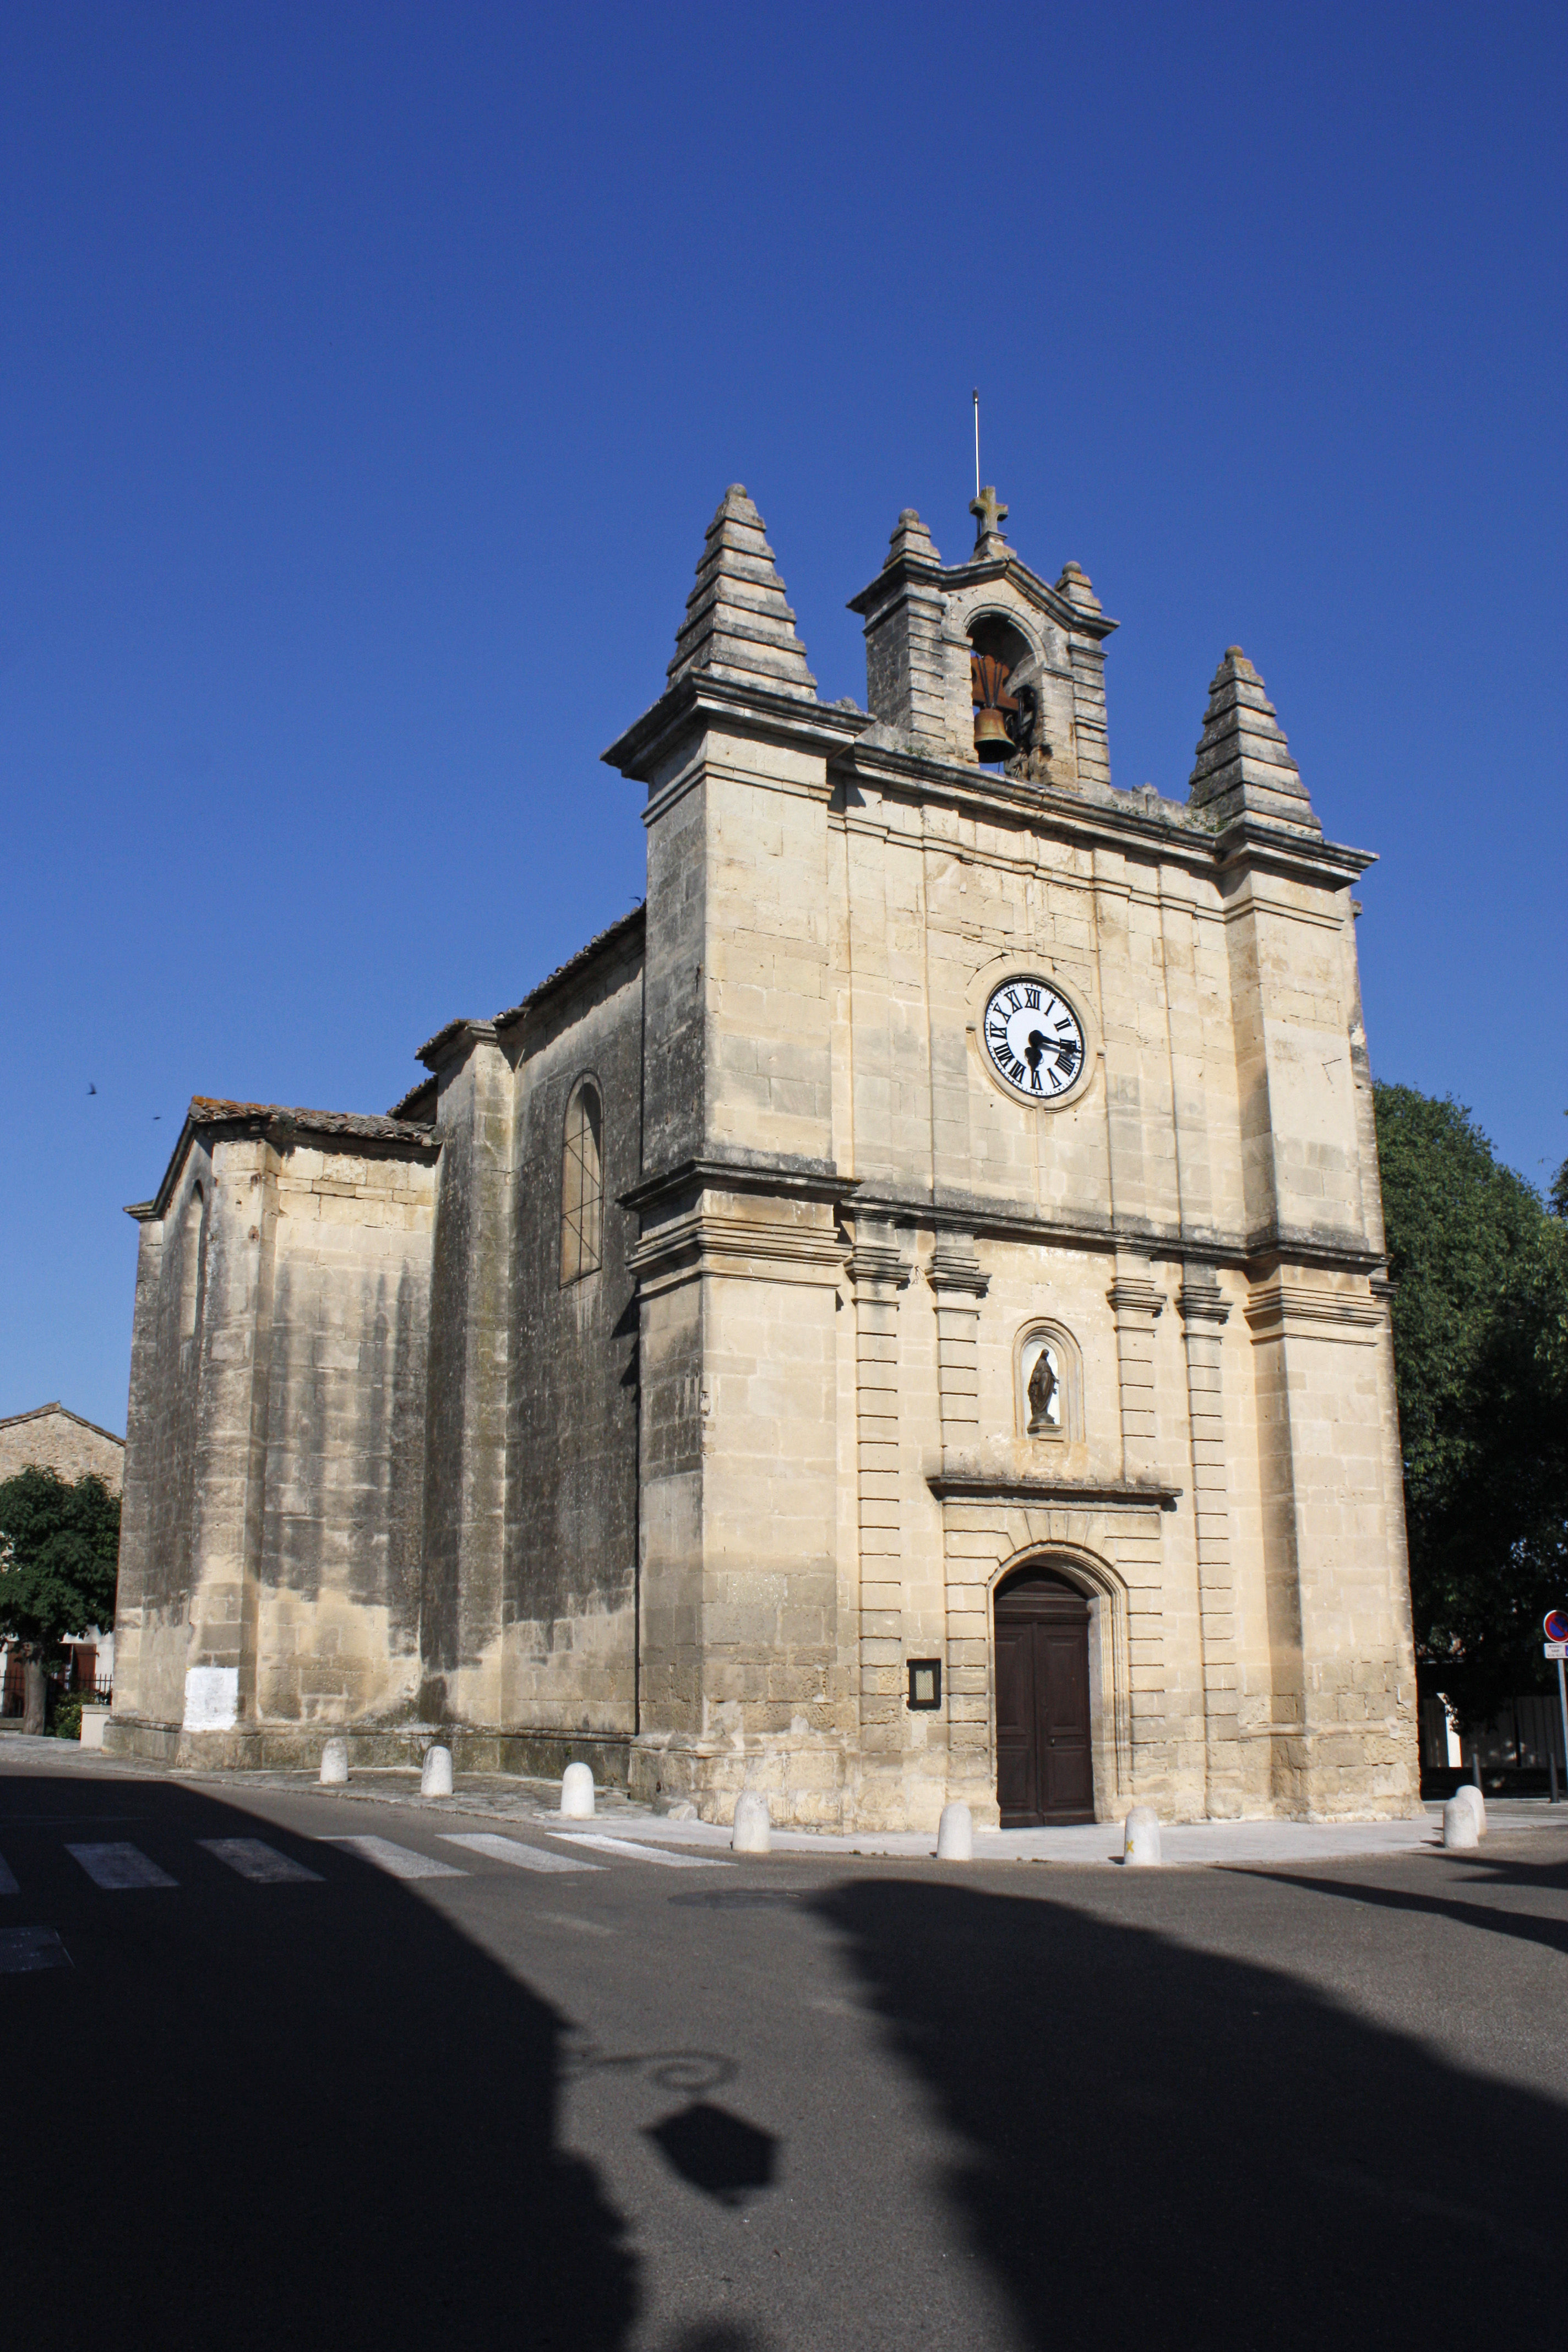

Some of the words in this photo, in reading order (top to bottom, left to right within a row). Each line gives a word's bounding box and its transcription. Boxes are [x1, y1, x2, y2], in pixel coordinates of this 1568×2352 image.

[1004, 989, 1023, 1014] XI
[1024, 988, 1041, 1011] XII
[1044, 999, 1056, 1016] I
[993, 1002, 1012, 1024] X
[989, 1021, 1008, 1039] IX
[1054, 1017, 1072, 1032] II
[993, 1042, 1015, 1069] VIII
[1008, 1059, 1026, 1084] VII
[1047, 1068, 1062, 1088] V
